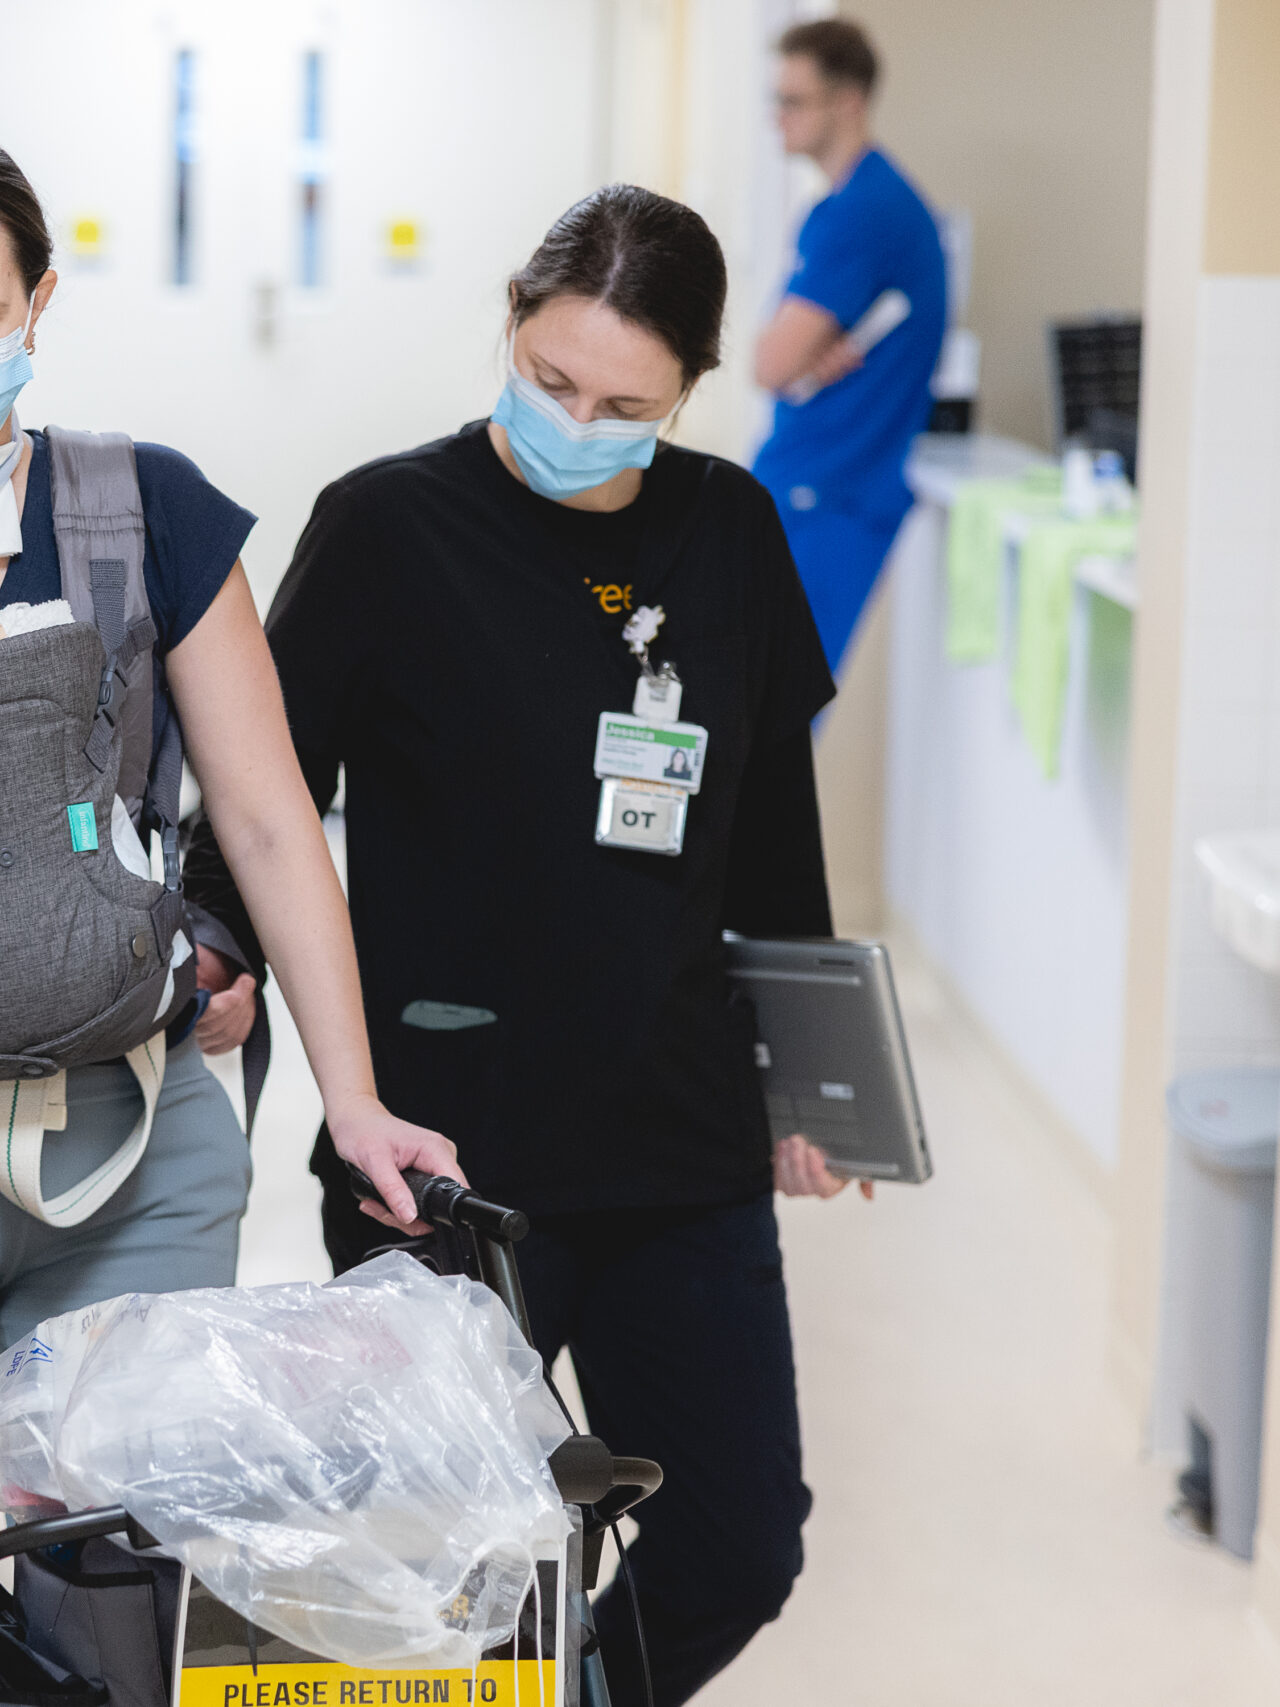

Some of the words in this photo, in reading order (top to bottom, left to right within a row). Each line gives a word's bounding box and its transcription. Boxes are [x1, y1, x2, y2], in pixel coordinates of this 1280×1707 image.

[622, 810, 657, 828] OT
[225, 1681, 328, 1707] PLEASE
[340, 1679, 450, 1704] RETURN
[462, 1678, 497, 1703] TO
